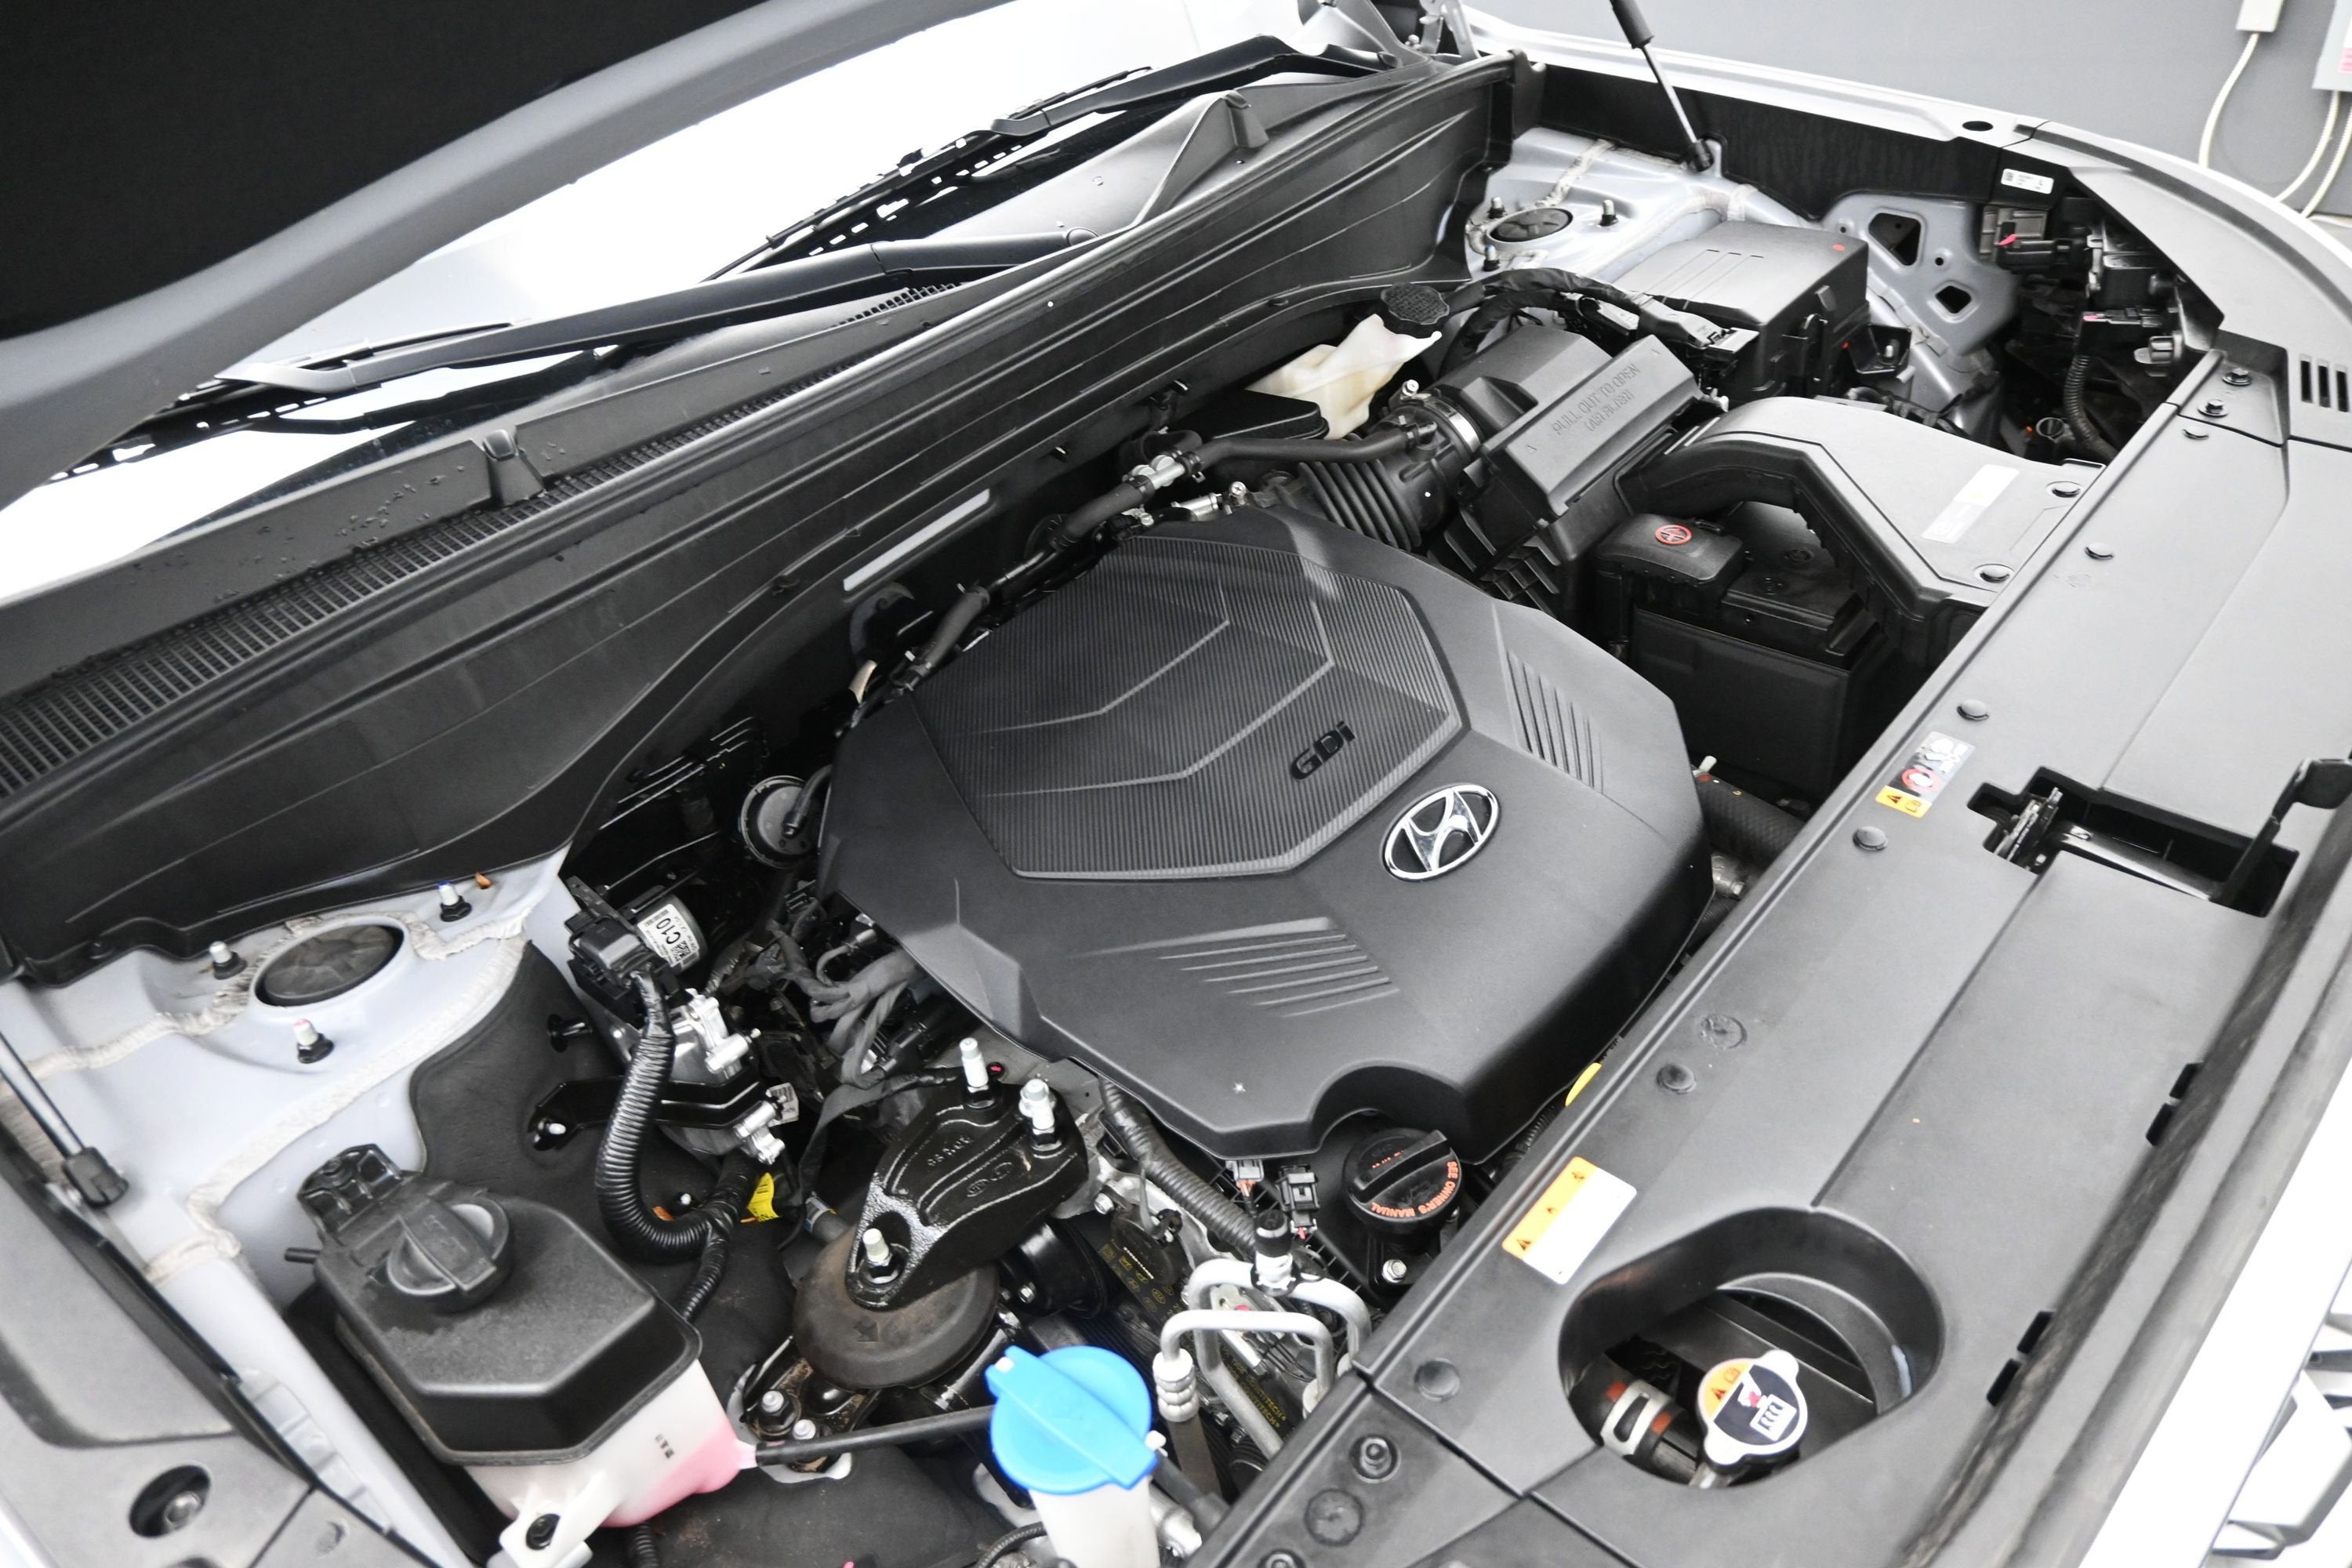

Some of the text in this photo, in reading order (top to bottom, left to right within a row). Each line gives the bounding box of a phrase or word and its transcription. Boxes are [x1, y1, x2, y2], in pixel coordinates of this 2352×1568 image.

[1552, 363, 1642, 435] PULL OUT TO OPEN
[656, 917, 681, 945] C10
[1371, 1161, 1458, 1218] SEE OWNER'S MANUAL
